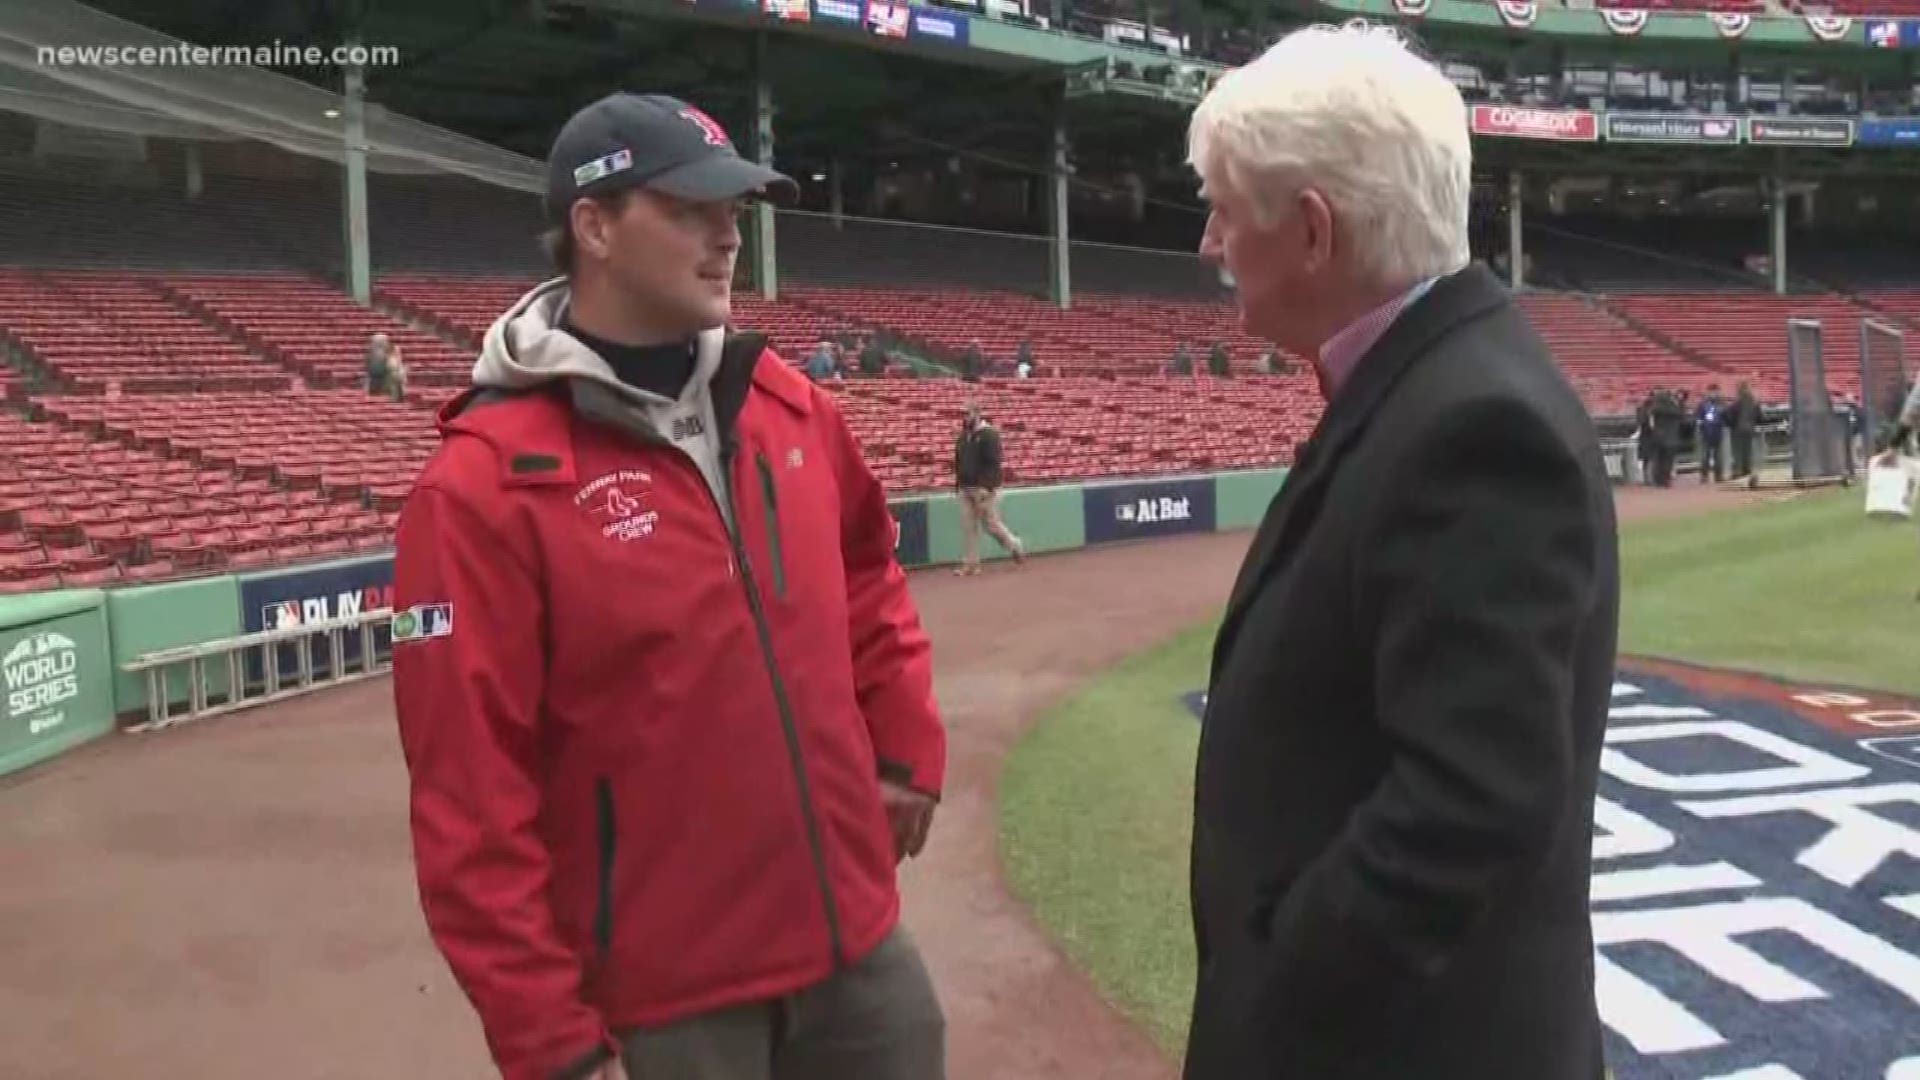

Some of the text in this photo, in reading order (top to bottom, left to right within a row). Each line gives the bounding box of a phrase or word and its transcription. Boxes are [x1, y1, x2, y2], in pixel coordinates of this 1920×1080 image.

[1137, 496, 1191, 522] At Bat
[4, 650, 76, 689] WORLD
[9, 674, 78, 716] SERIES
